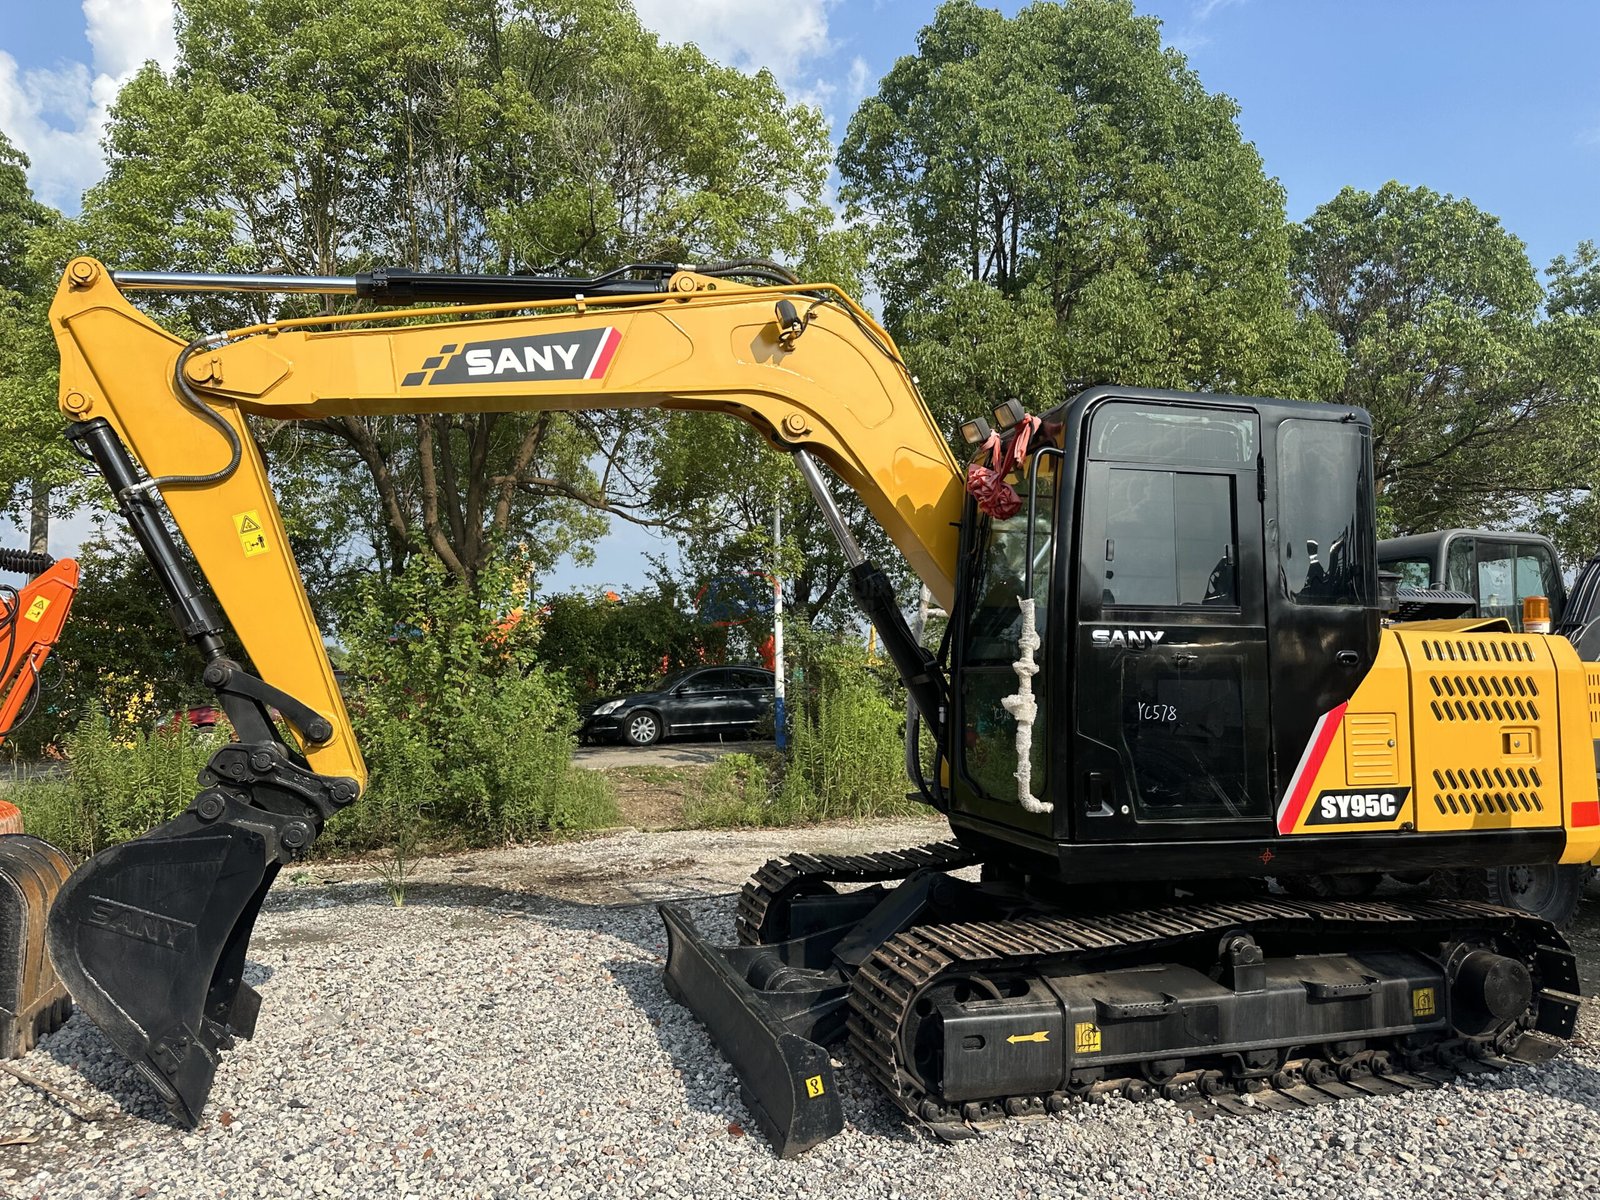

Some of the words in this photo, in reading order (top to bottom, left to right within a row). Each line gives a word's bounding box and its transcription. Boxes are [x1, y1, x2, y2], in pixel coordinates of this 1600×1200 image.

[465, 344, 580, 376] SANY
[1092, 629, 1165, 648] SANY
[1138, 701, 1177, 722] YC578
[1320, 793, 1396, 819] SY95C
[88, 904, 188, 949] SANY
